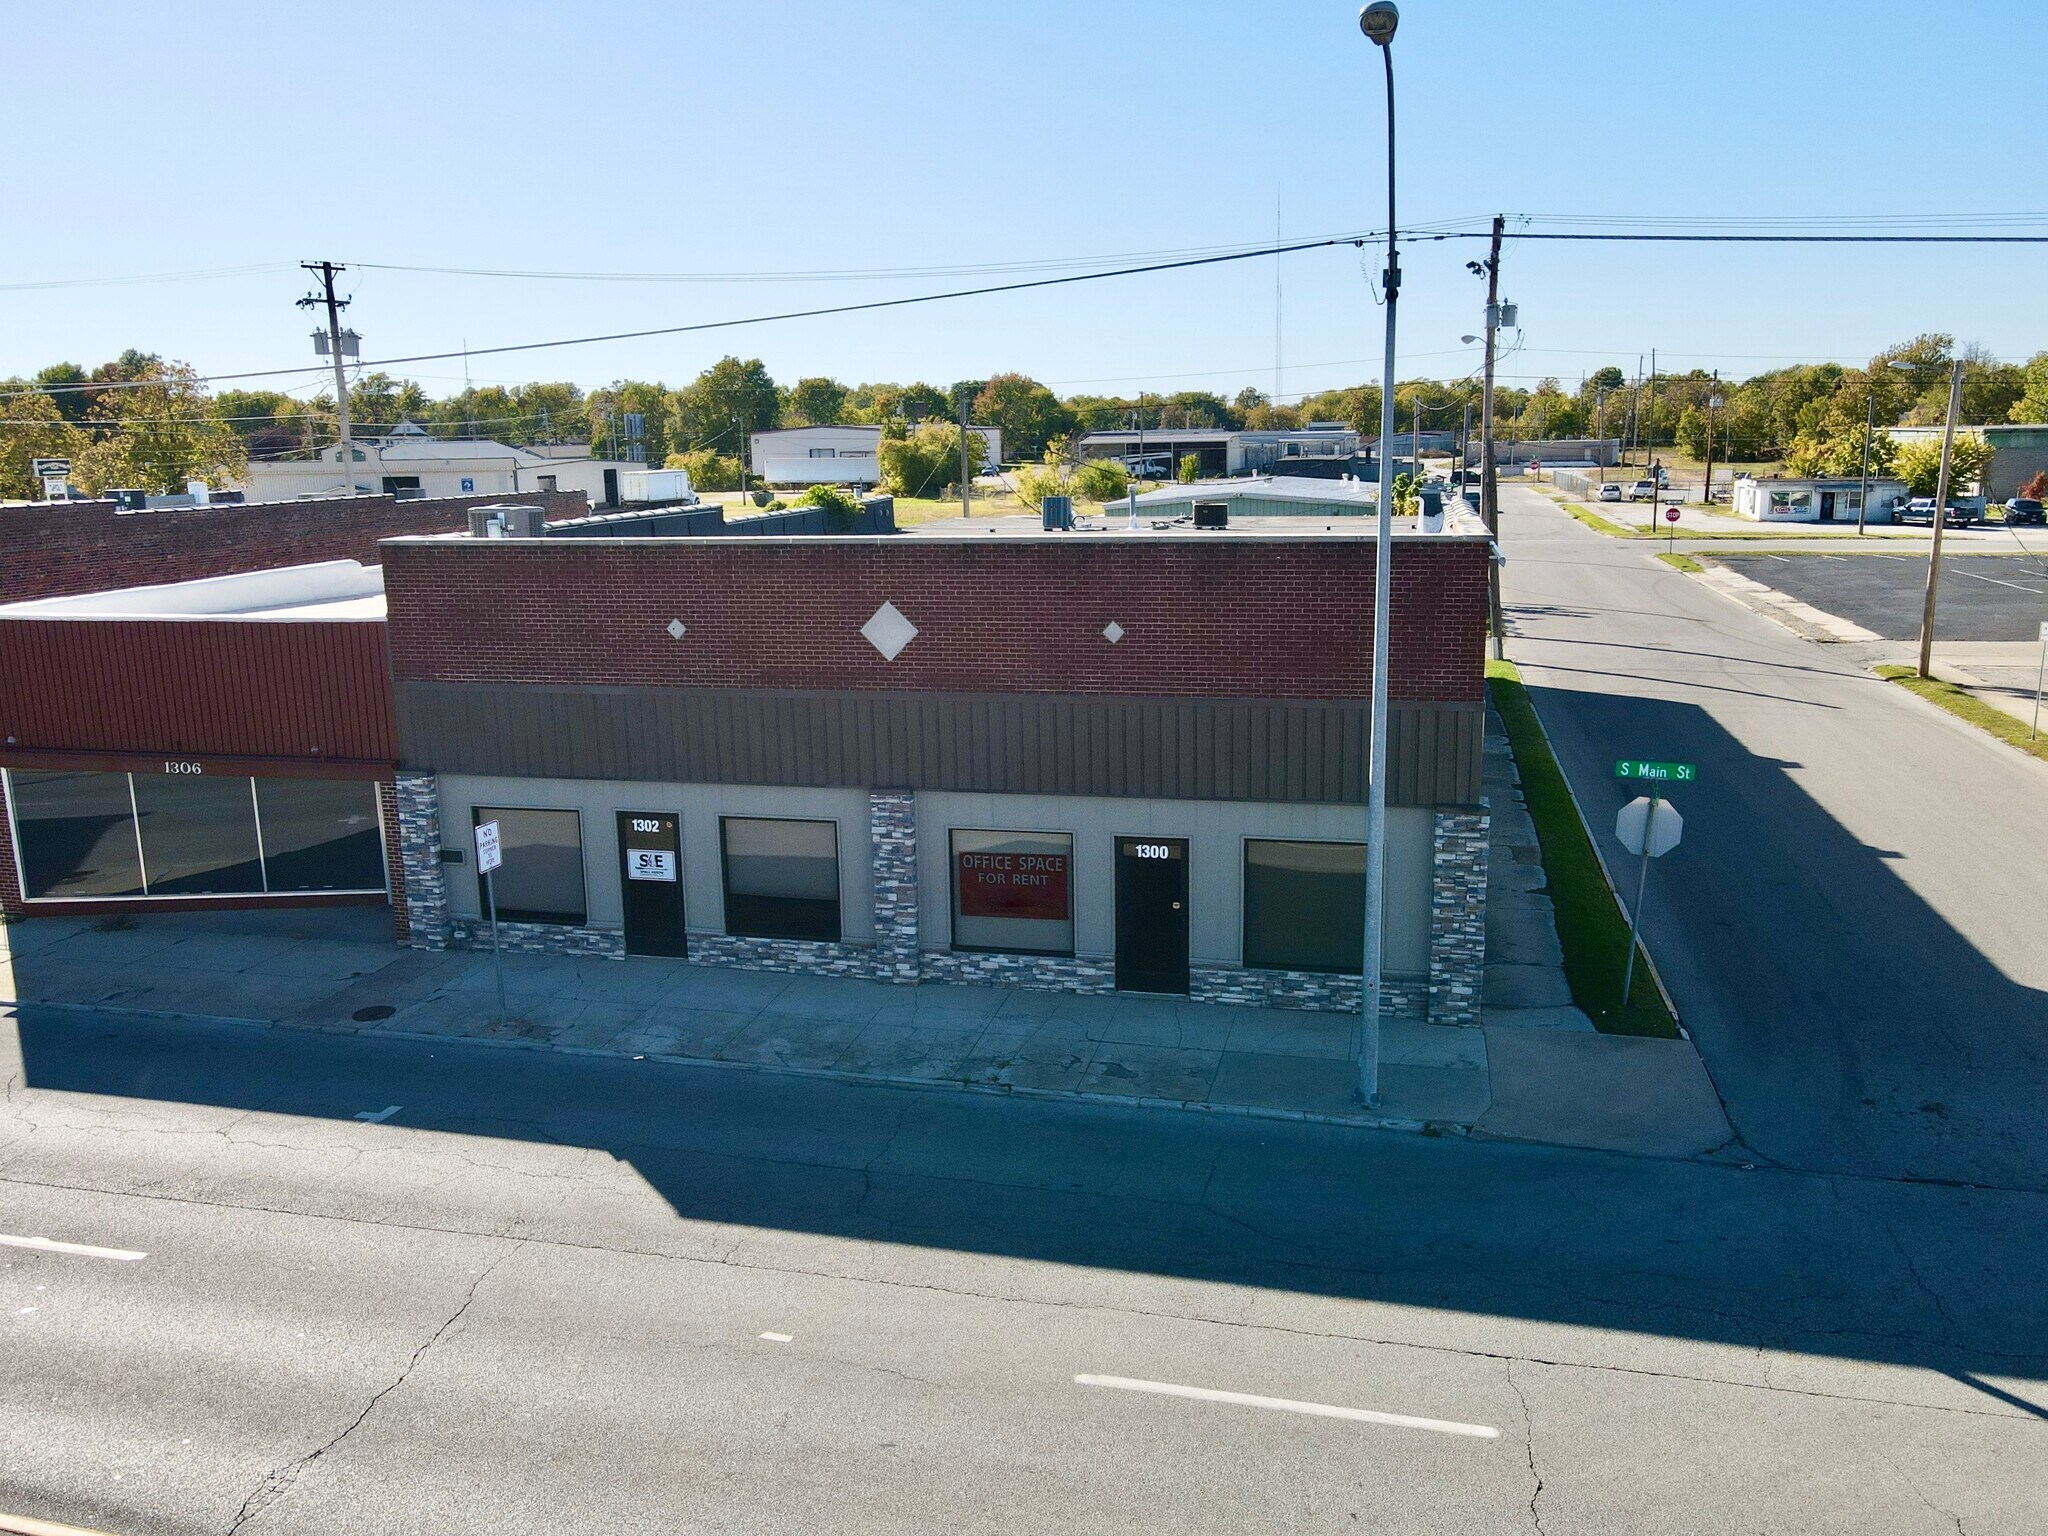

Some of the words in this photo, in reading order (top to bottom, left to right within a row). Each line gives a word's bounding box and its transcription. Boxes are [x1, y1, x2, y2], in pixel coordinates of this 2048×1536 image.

[165, 761, 202, 775] 1306
[1620, 762, 1630, 776] S
[1638, 763, 1667, 778] Main
[1676, 765, 1691, 779] St
[483, 828, 492, 838] NO
[631, 819, 660, 833] 1302
[480, 837, 498, 849] PARKING
[1135, 844, 1169, 860] 1300
[963, 854, 1012, 871] OFFICE
[1019, 856, 1063, 872] SPACE
[978, 872, 1006, 884] FOR
[1012, 874, 1049, 886] RENT
